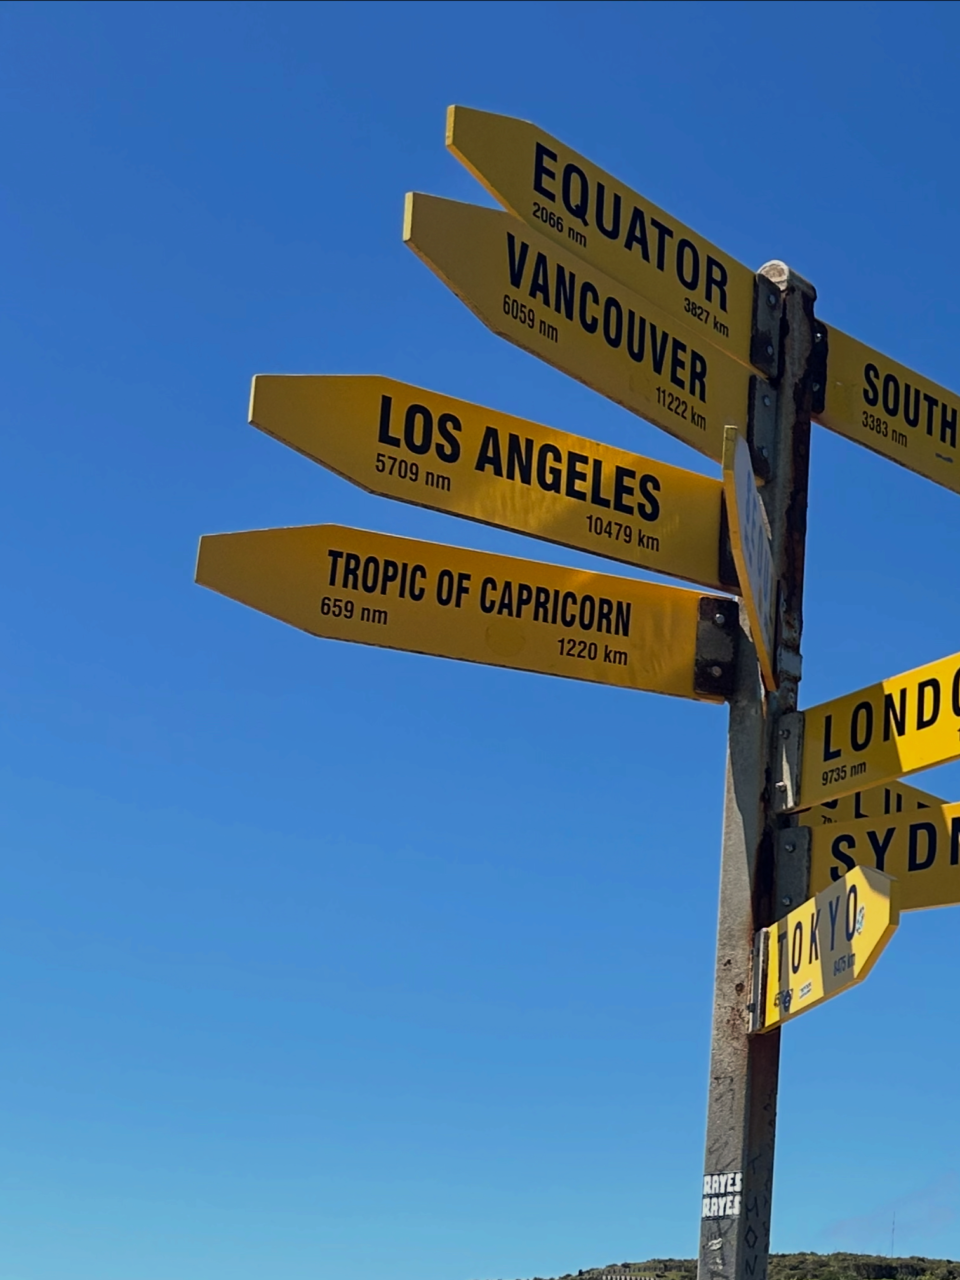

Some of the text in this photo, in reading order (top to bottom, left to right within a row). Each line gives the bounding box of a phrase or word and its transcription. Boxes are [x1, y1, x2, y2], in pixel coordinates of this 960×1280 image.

[532, 202, 587, 248] 2066 nm
[533, 141, 728, 313] EQUATOR
[502, 293, 558, 343] 6059 nm
[506, 231, 707, 403] VANCOUVER
[684, 297, 729, 338] 3827 km
[655, 386, 707, 432] 11222 km
[862, 410, 908, 448] 3383 nm
[863, 363, 957, 449] SOUTH
[375, 453, 451, 492] 5709 nm
[378, 394, 661, 522] LOS ANGELES
[585, 514, 660, 552] 10479 km
[320, 596, 388, 625] 659 nm
[327, 549, 632, 638] TROPIC OF CAPRICORN
[557, 637, 628, 666] 1220 km
[821, 760, 867, 786] 9735 nm
[778, 884, 857, 982] TOKYO
